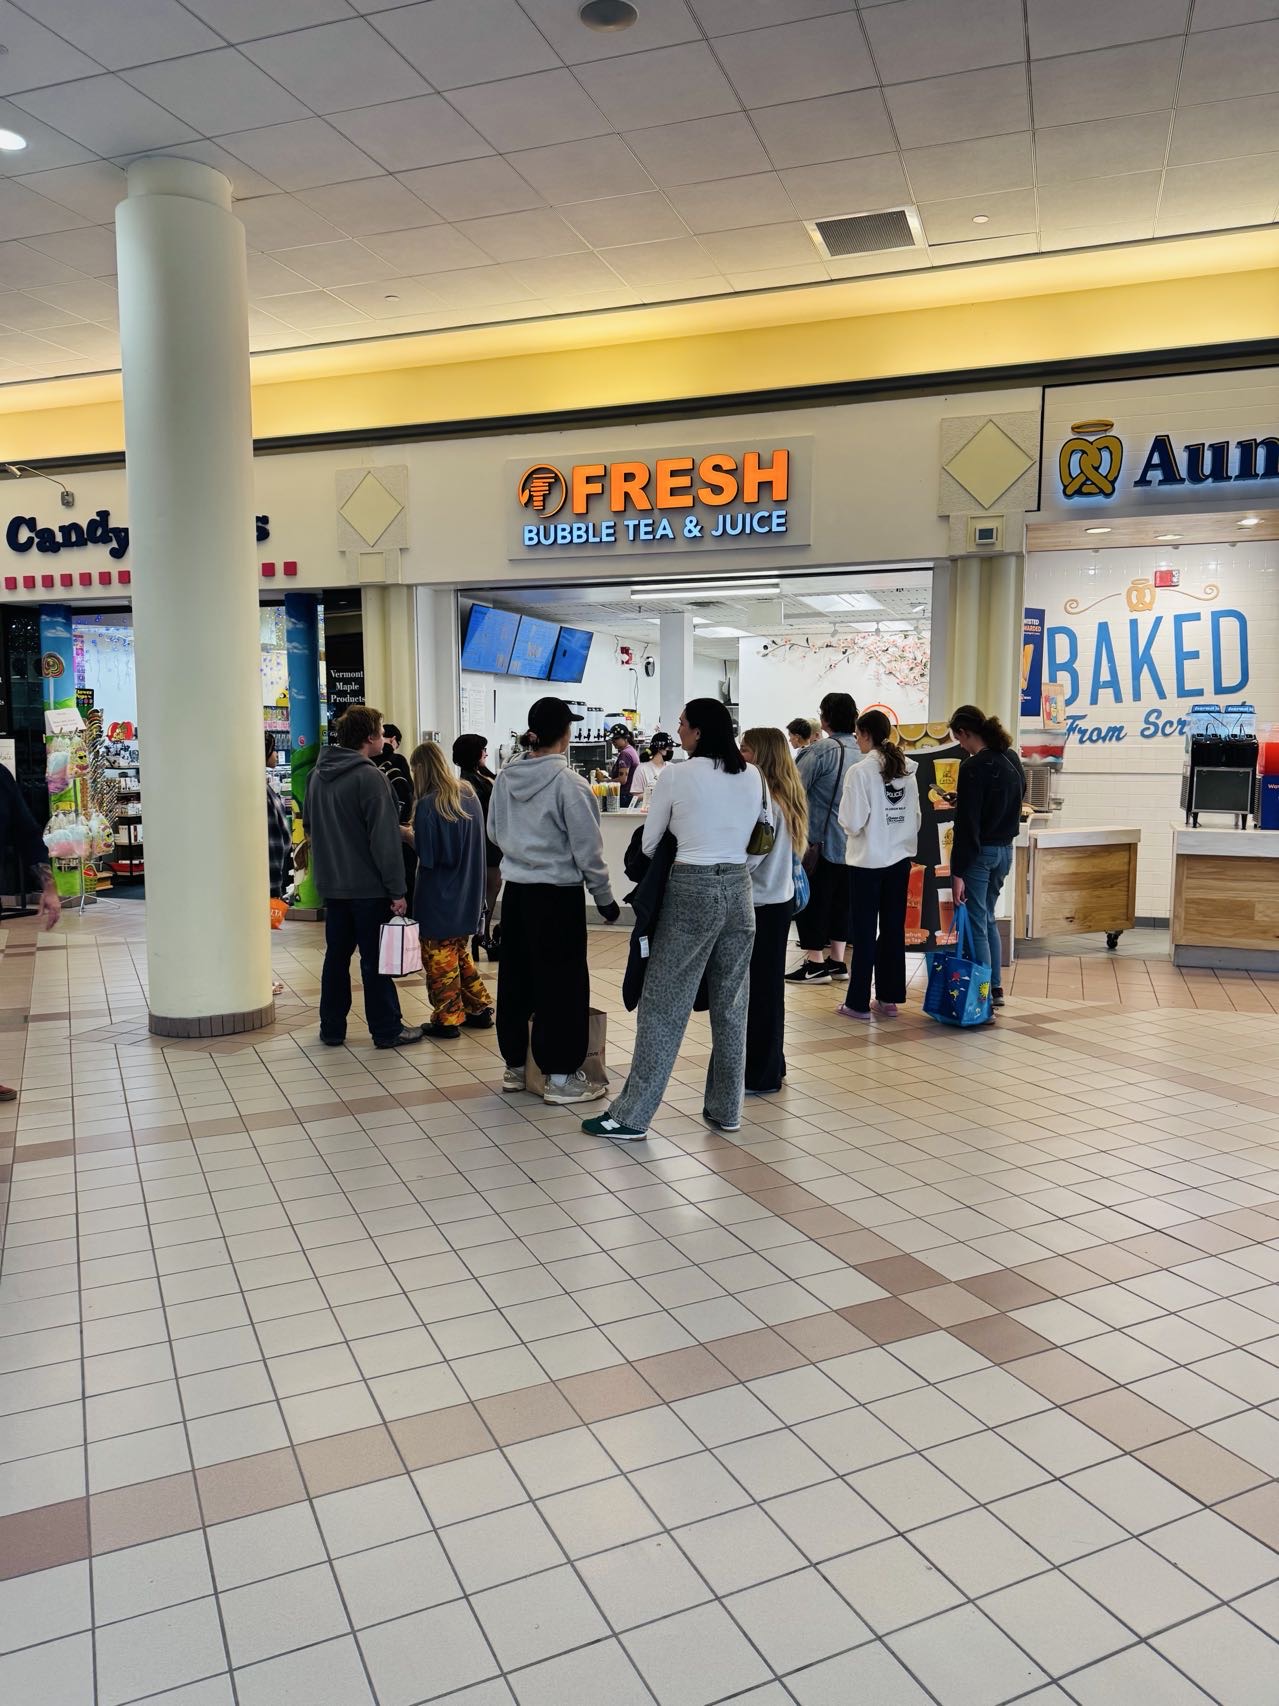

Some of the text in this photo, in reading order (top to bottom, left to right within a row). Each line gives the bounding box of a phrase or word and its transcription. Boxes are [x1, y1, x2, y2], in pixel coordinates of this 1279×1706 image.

[572, 449, 790, 514] FRESH
[6, 509, 130, 559] Candy
[523, 509, 788, 547] BUBBLE TEA & JUICE
[330, 669, 364, 678] Vermont
[1047, 609, 1250, 706] BAKED
[330, 694, 366, 703] Products
[335, 682, 360, 692] Maple
[1065, 708, 1187, 745] From Scr
